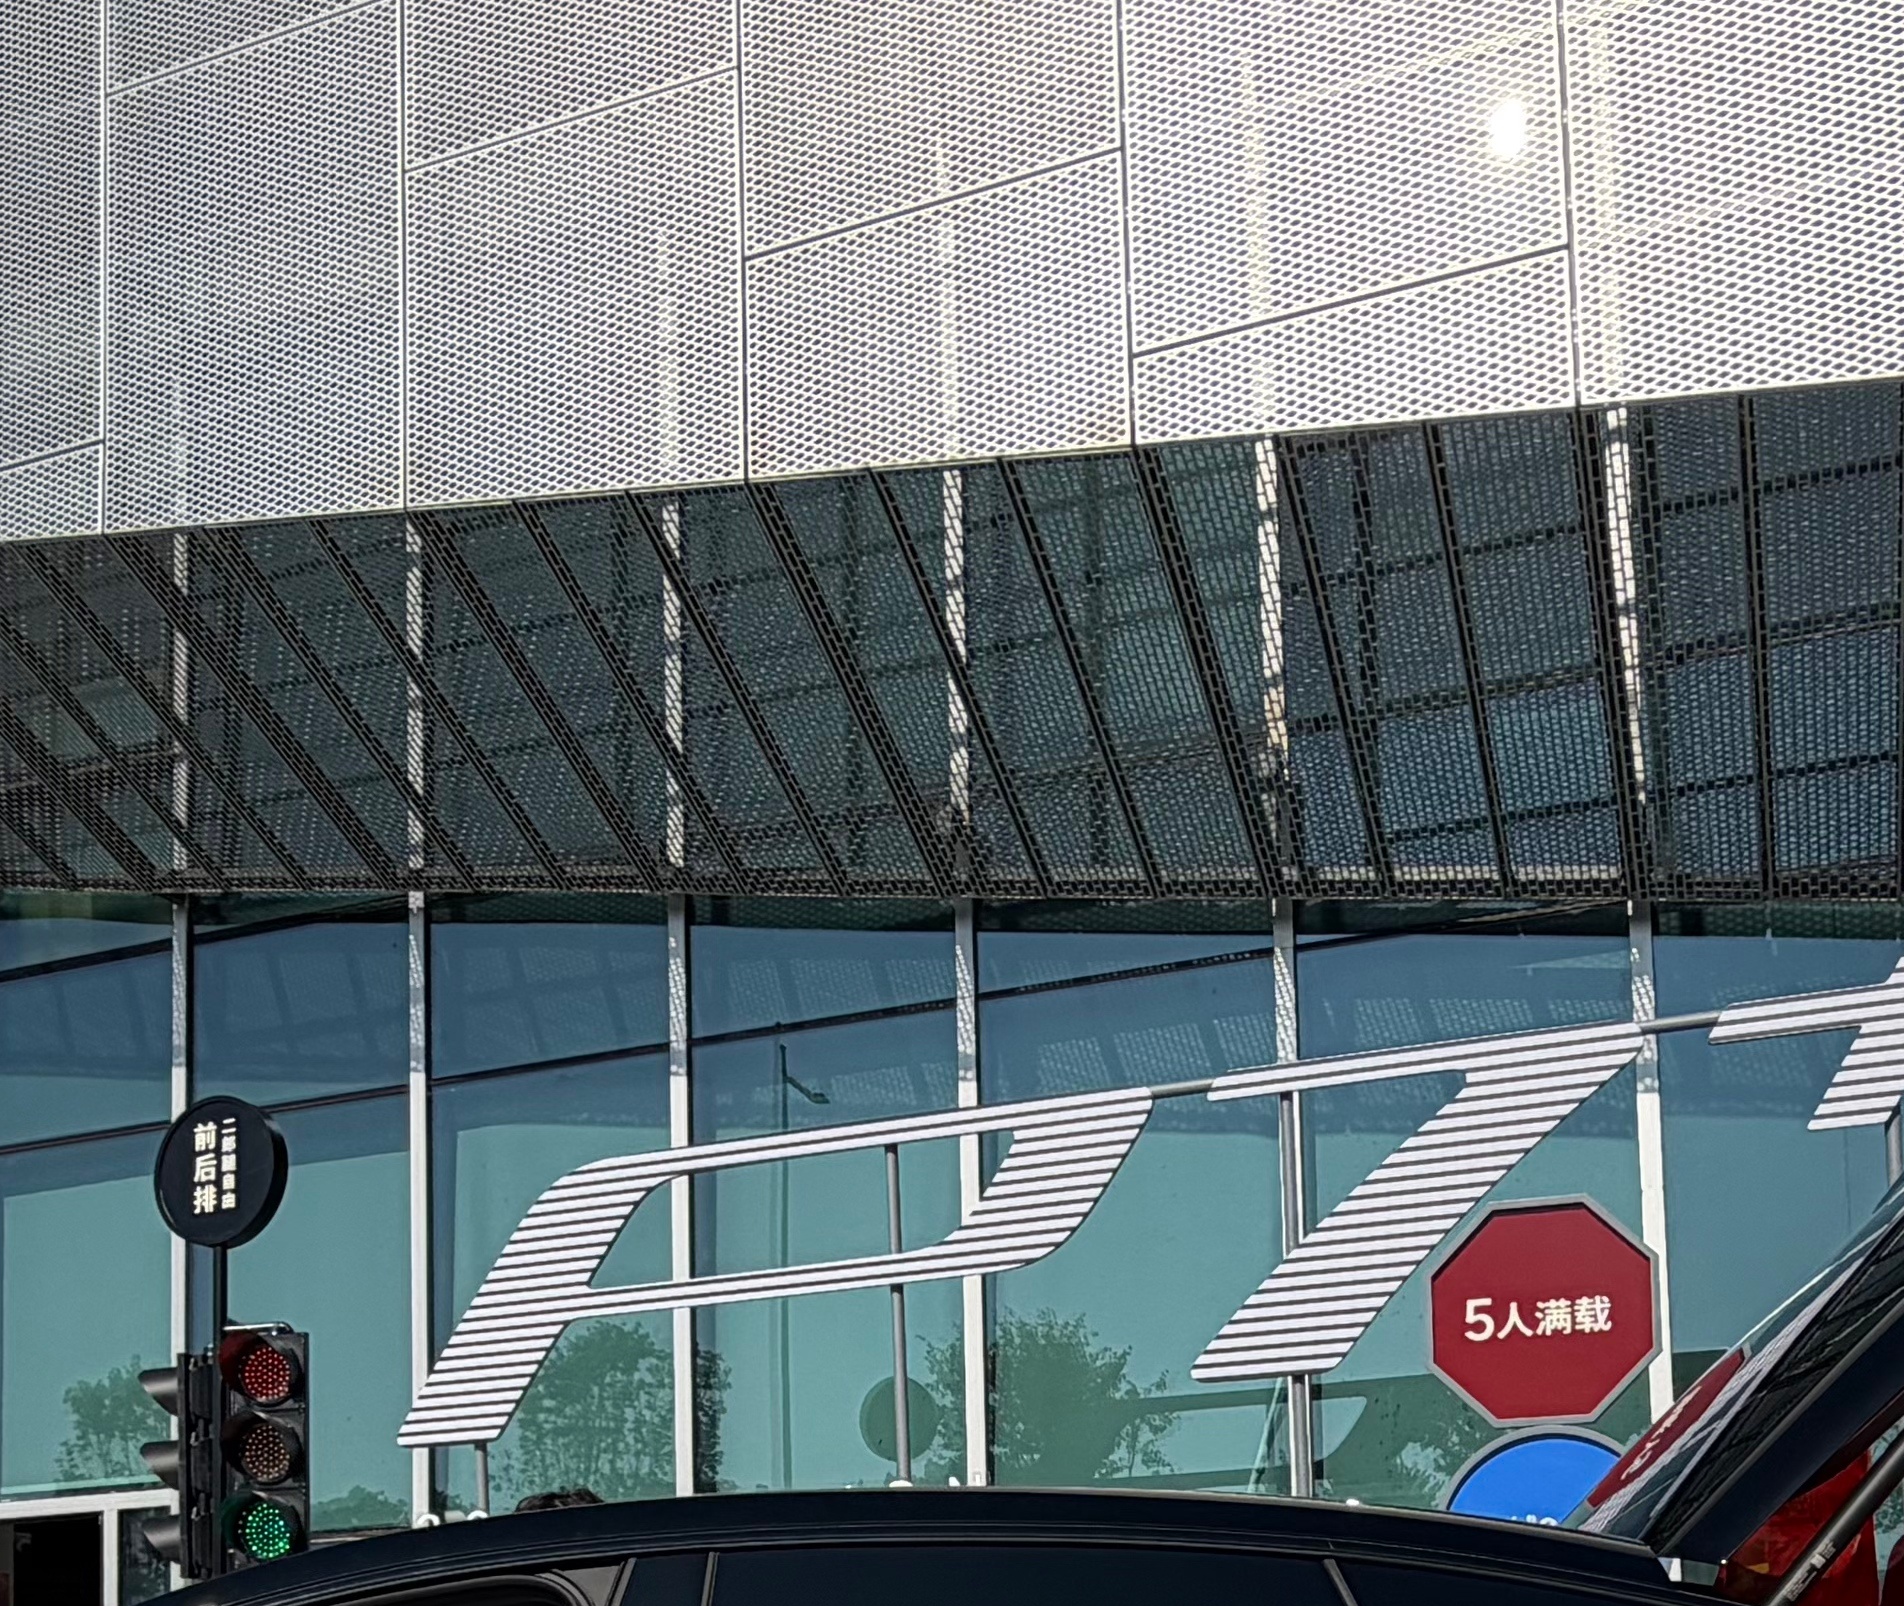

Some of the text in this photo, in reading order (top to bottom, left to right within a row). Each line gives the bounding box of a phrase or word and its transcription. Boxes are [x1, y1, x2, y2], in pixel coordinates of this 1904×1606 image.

[193, 1121, 218, 1215] 前后排
[1463, 1294, 1614, 1343] 5人满载
